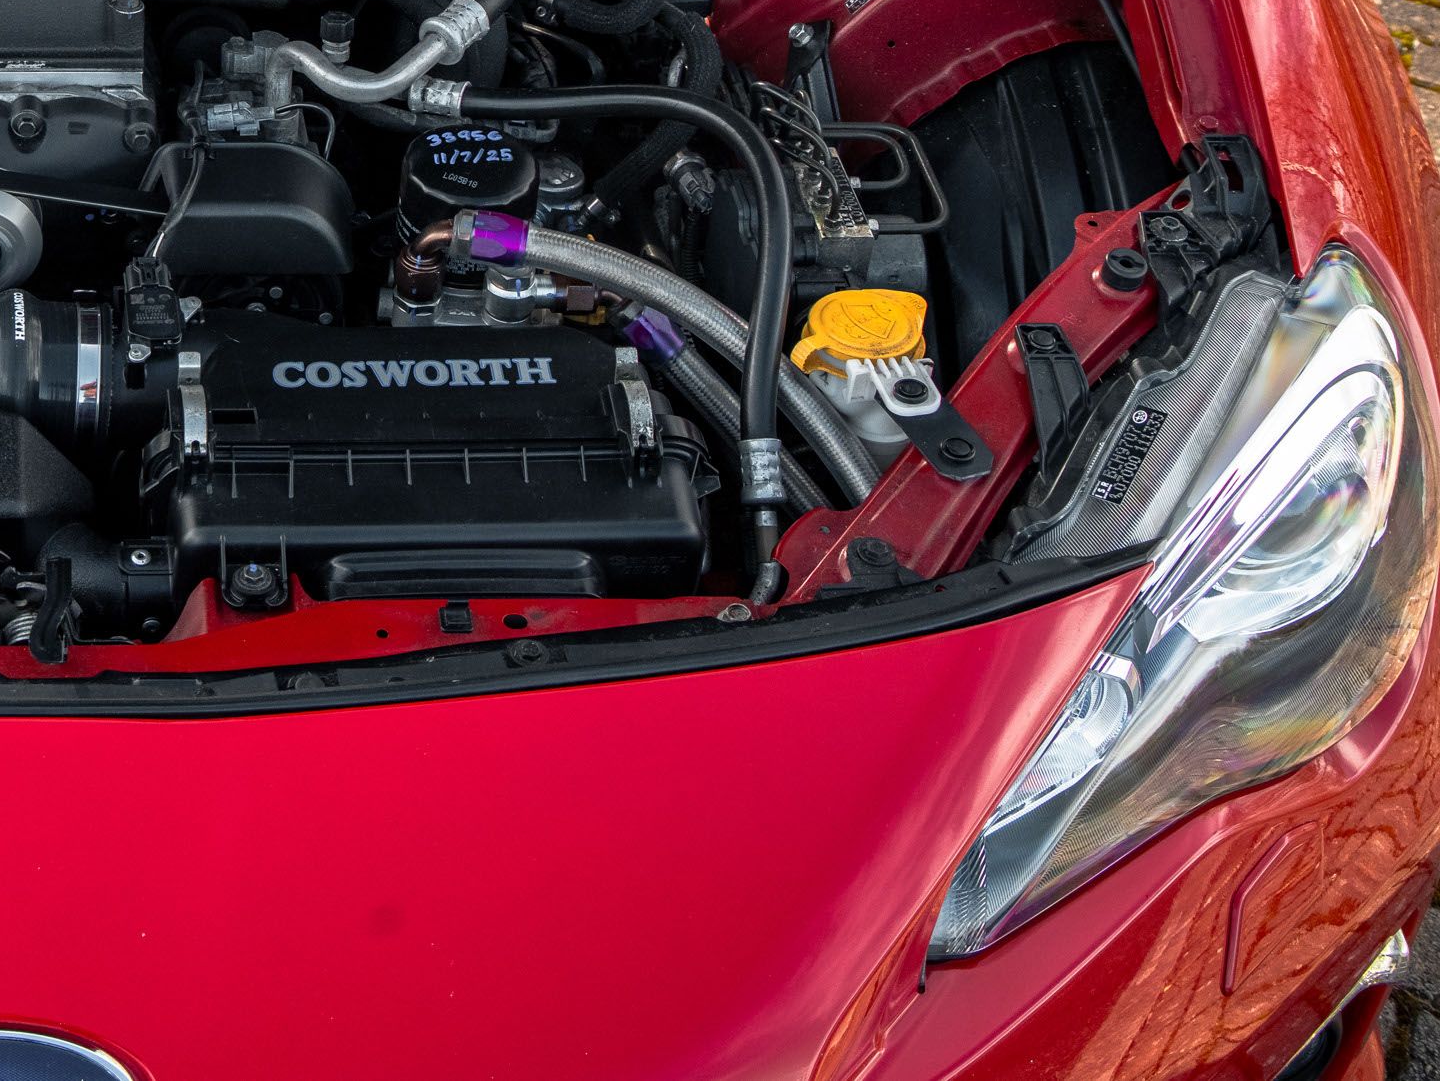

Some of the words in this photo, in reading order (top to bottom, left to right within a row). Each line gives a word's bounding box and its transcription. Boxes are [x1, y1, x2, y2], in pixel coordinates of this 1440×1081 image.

[433, 148, 514, 165] 11/7/25
[13, 292, 26, 341] COSWORTH
[272, 357, 557, 389] COSWORTH
[1103, 424, 1141, 479] BCH9707
[1134, 412, 1165, 452] 111333
